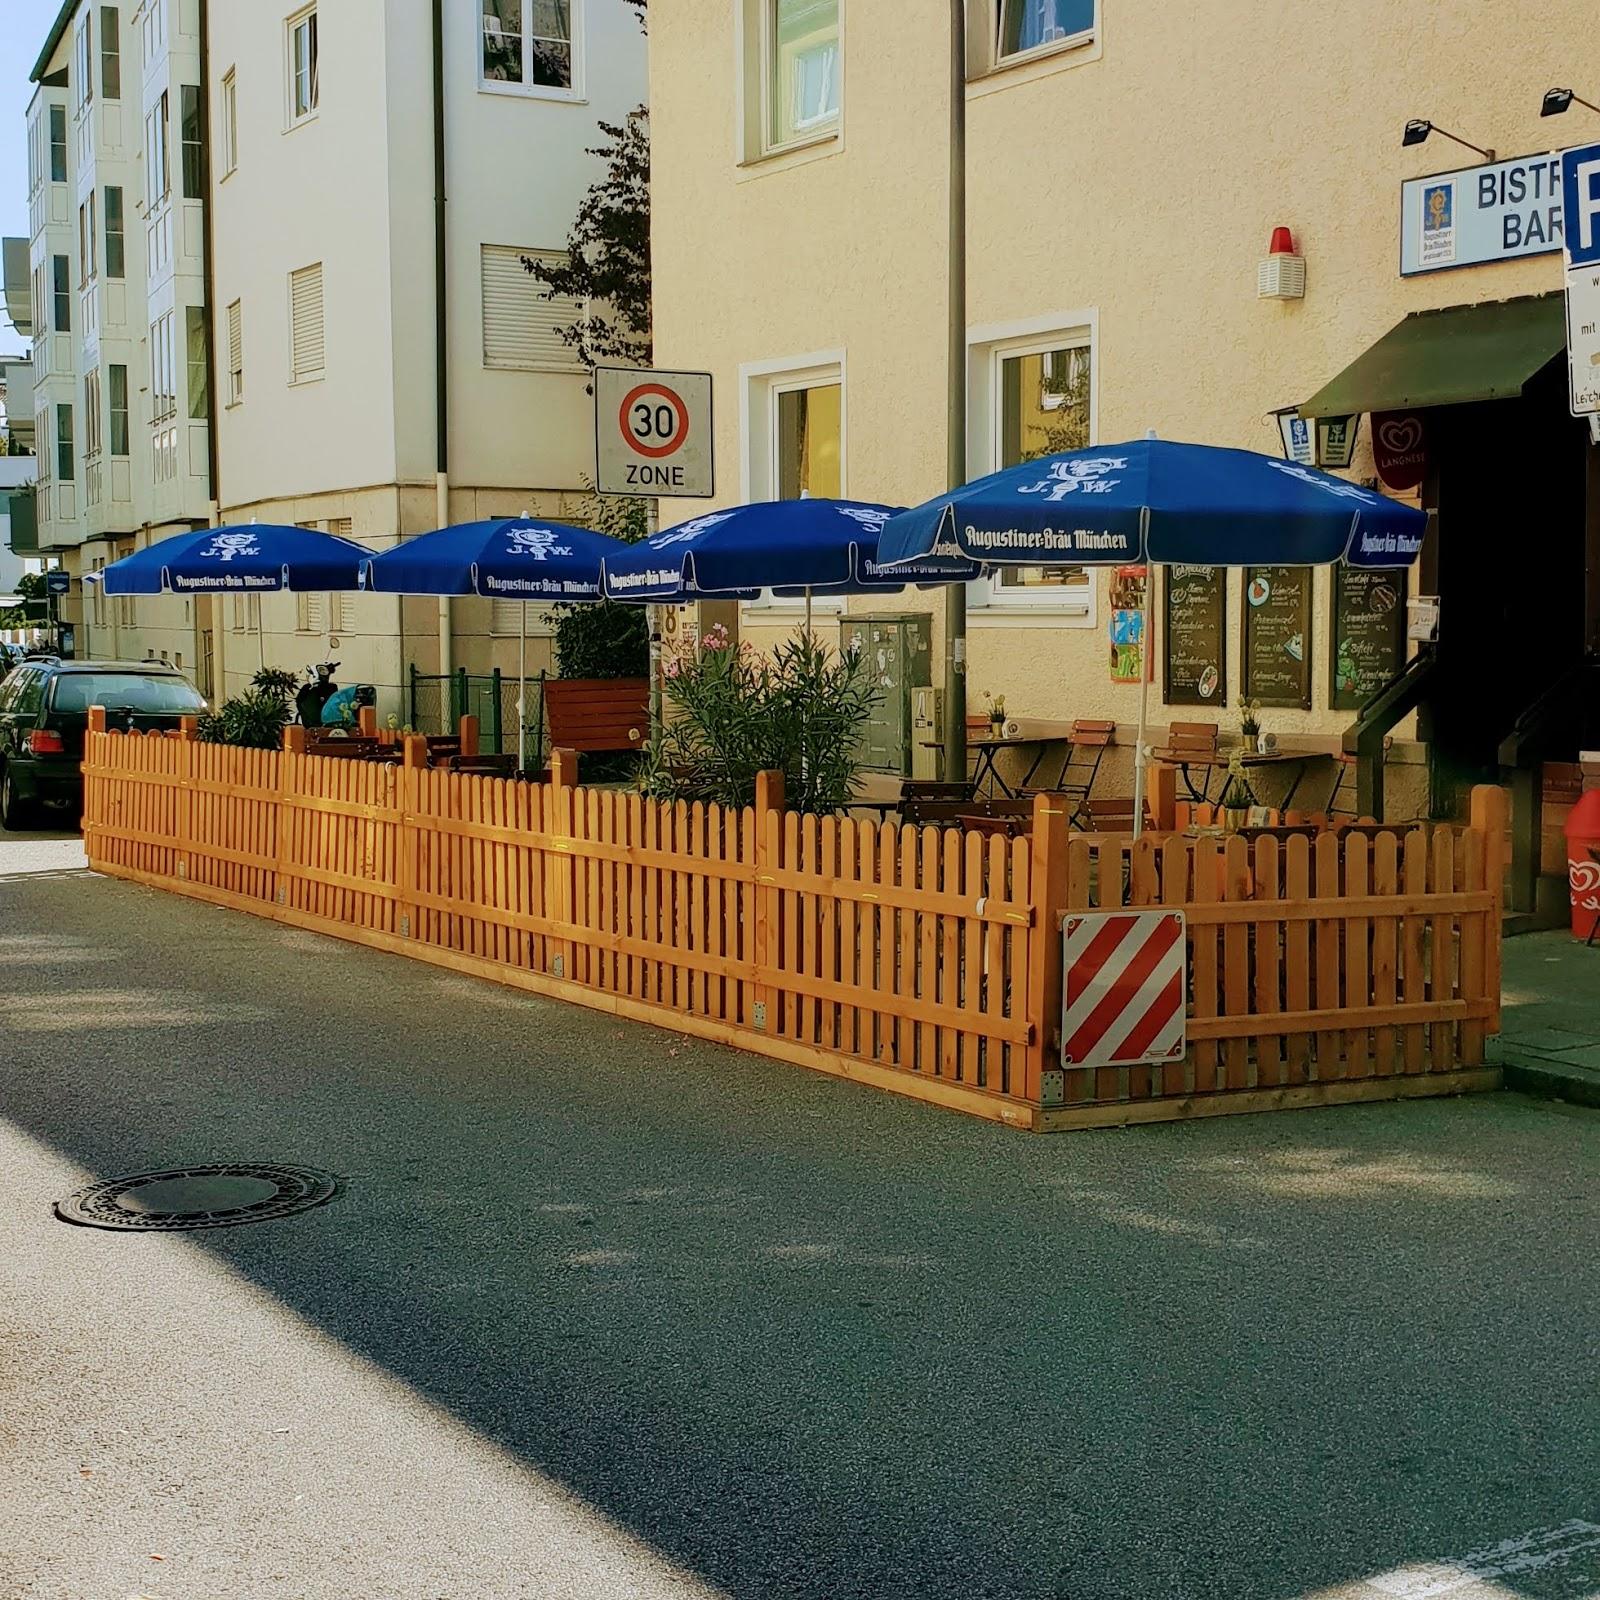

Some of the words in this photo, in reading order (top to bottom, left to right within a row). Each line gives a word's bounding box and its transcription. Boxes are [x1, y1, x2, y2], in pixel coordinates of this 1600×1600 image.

[1503, 205, 1563, 250] BAR
[1581, 321, 1596, 336] mit
[634, 404, 674, 438] 30
[626, 464, 685, 486] ZONE
[1074, 529, 1128, 549] München
